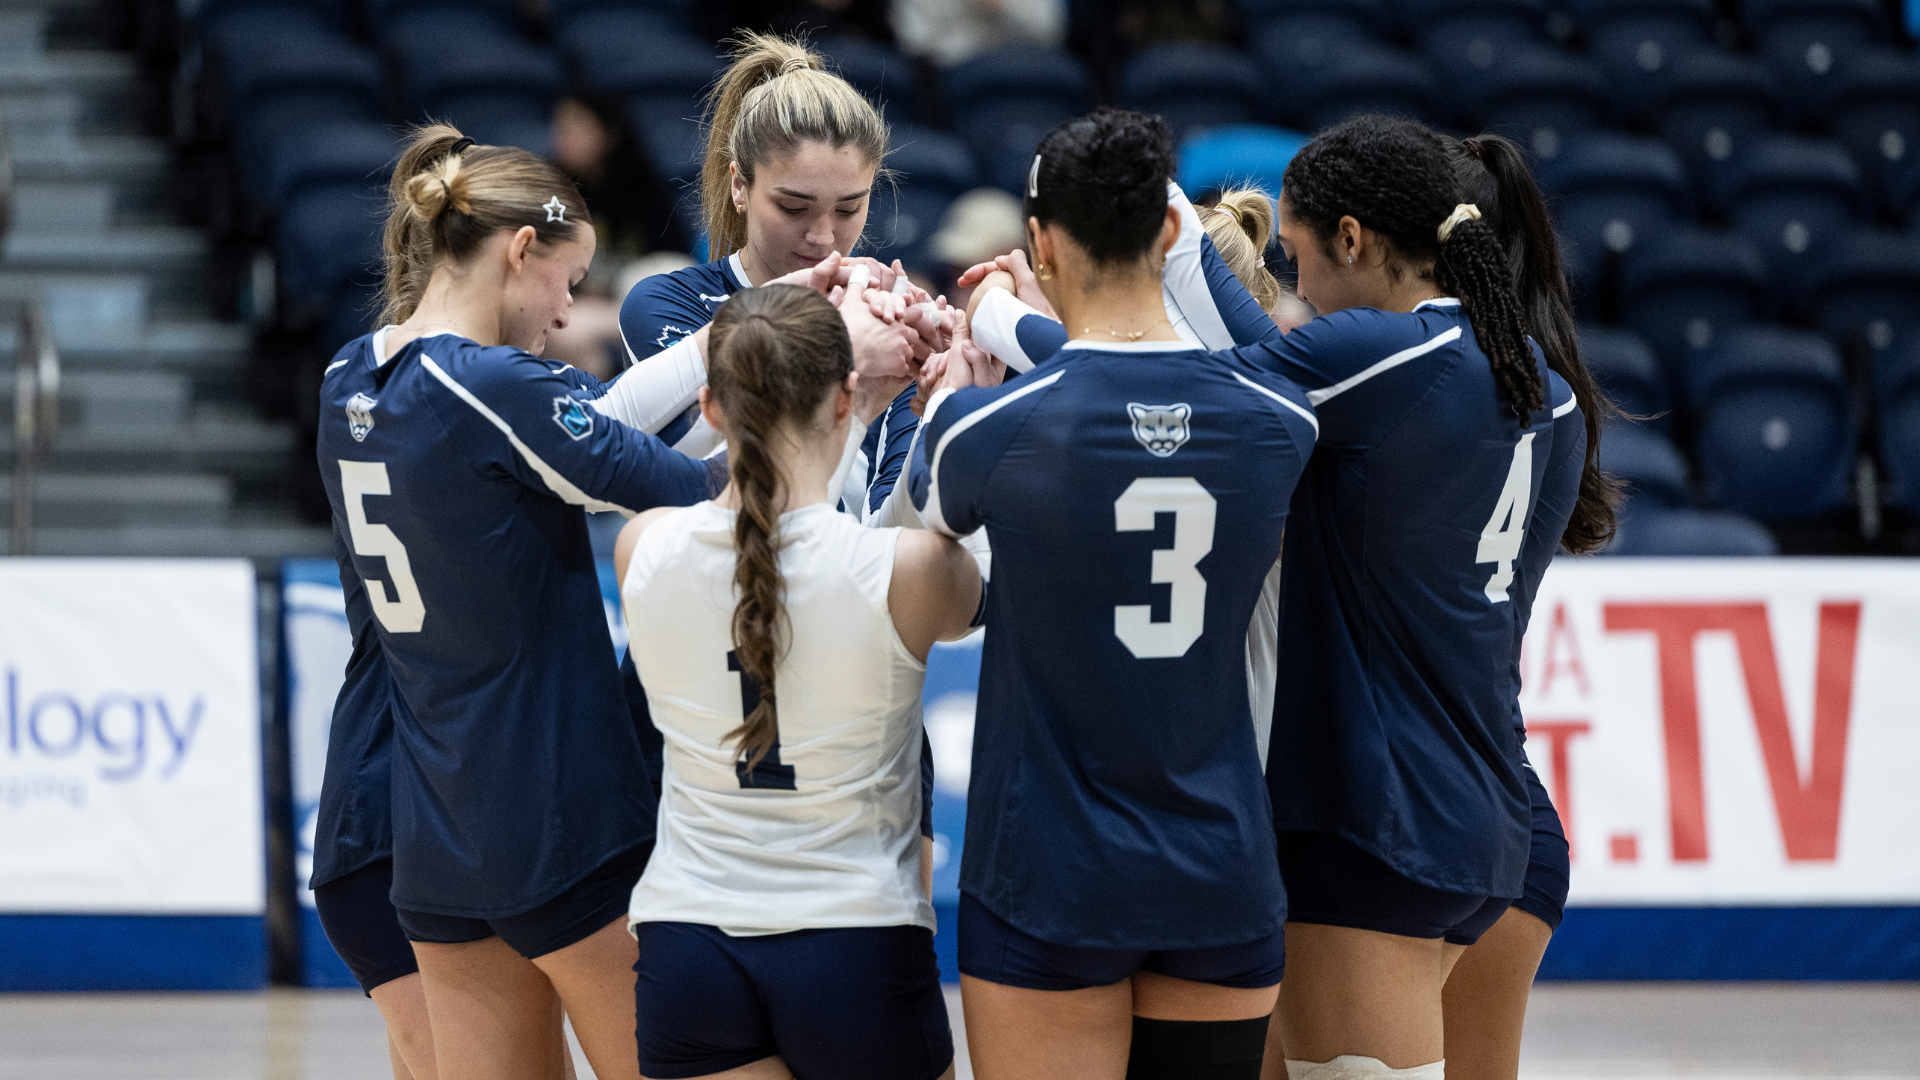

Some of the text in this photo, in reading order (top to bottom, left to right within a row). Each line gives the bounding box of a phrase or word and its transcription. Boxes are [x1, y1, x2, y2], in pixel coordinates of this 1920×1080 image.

[337, 459, 426, 633] 5
[1114, 477, 1217, 658] 3
[1475, 432, 1536, 603] 4
[0, 665, 206, 783] logy
[727, 648, 798, 790] 1
[1519, 600, 1591, 694] A
